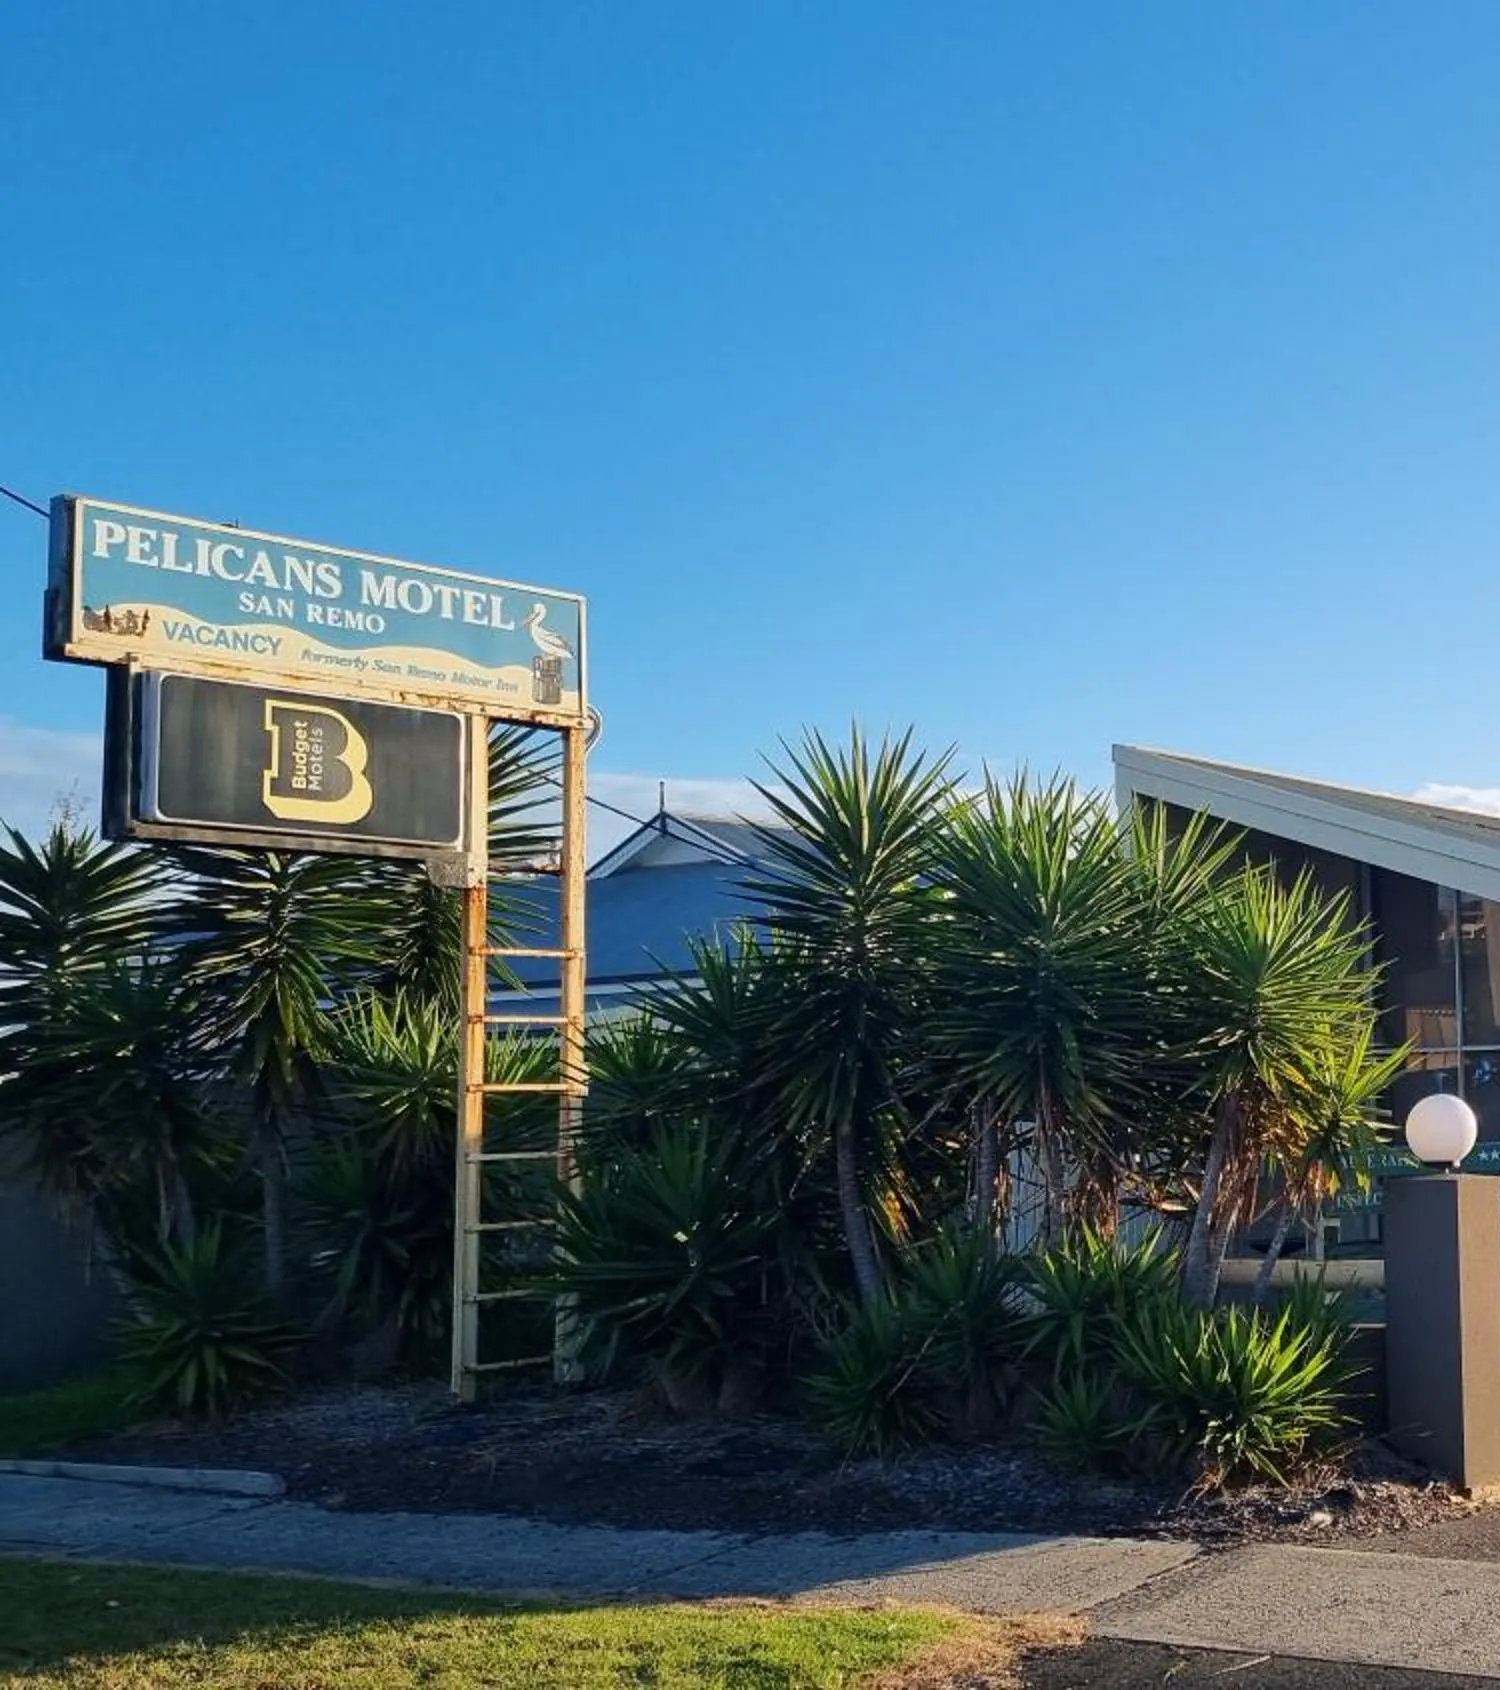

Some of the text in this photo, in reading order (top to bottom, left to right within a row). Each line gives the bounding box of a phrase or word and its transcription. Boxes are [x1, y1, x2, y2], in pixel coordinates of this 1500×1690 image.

[93, 519, 515, 632] PELICANS MOTEL
[163, 619, 283, 656] VACANCY
[239, 591, 386, 635] SAN REMO
[373, 659, 401, 675] San
[452, 671, 494, 688] Motor
[497, 677, 519, 693] Inn
[292, 721, 310, 789] Budget
[308, 727, 323, 790] Motels
